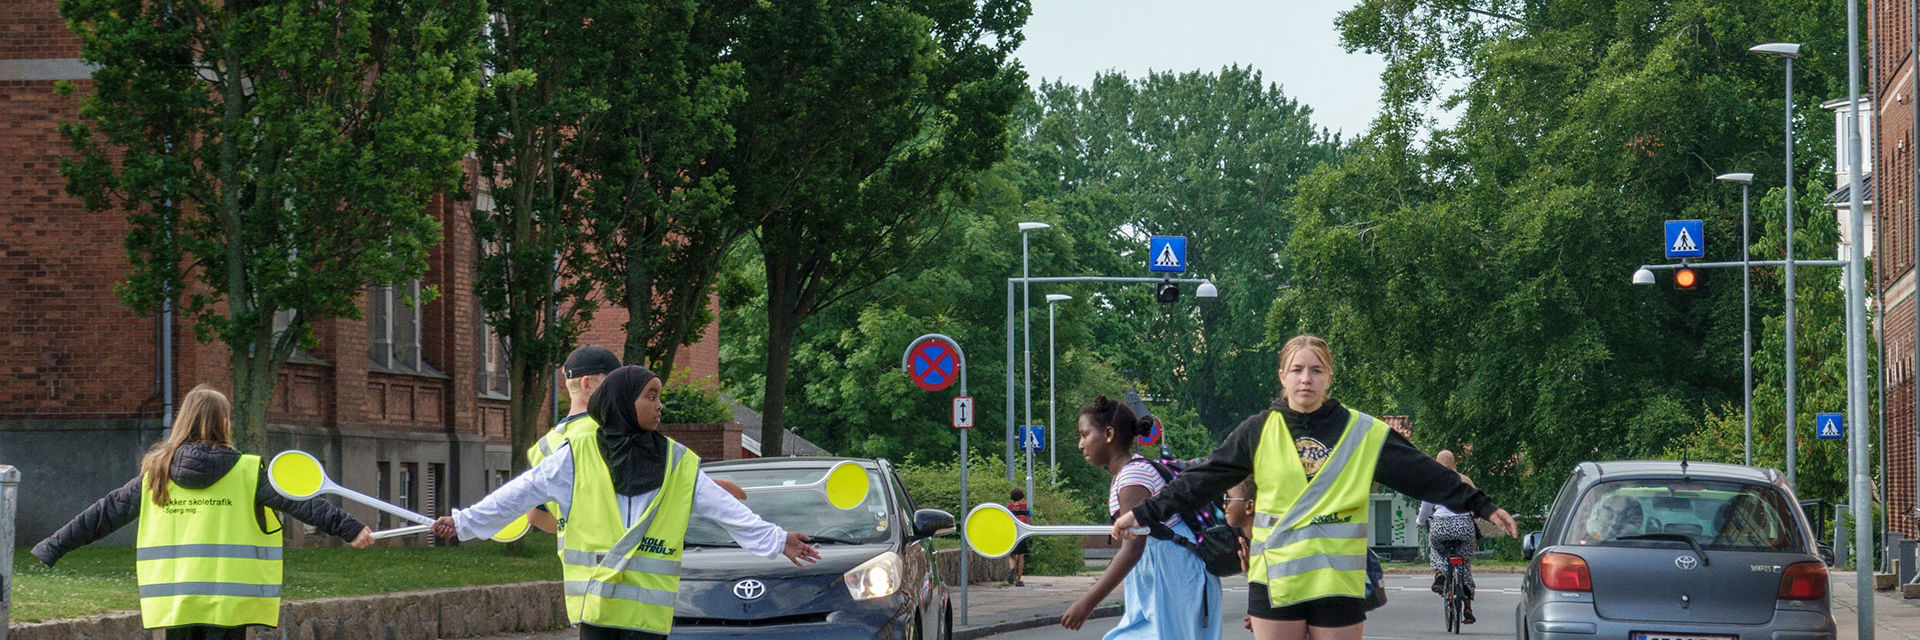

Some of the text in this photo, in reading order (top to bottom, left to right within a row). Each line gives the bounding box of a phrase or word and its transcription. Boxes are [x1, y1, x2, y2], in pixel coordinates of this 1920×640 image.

[165, 498, 233, 507] kker skoletrafik
[640, 536, 666, 547] KOLE
